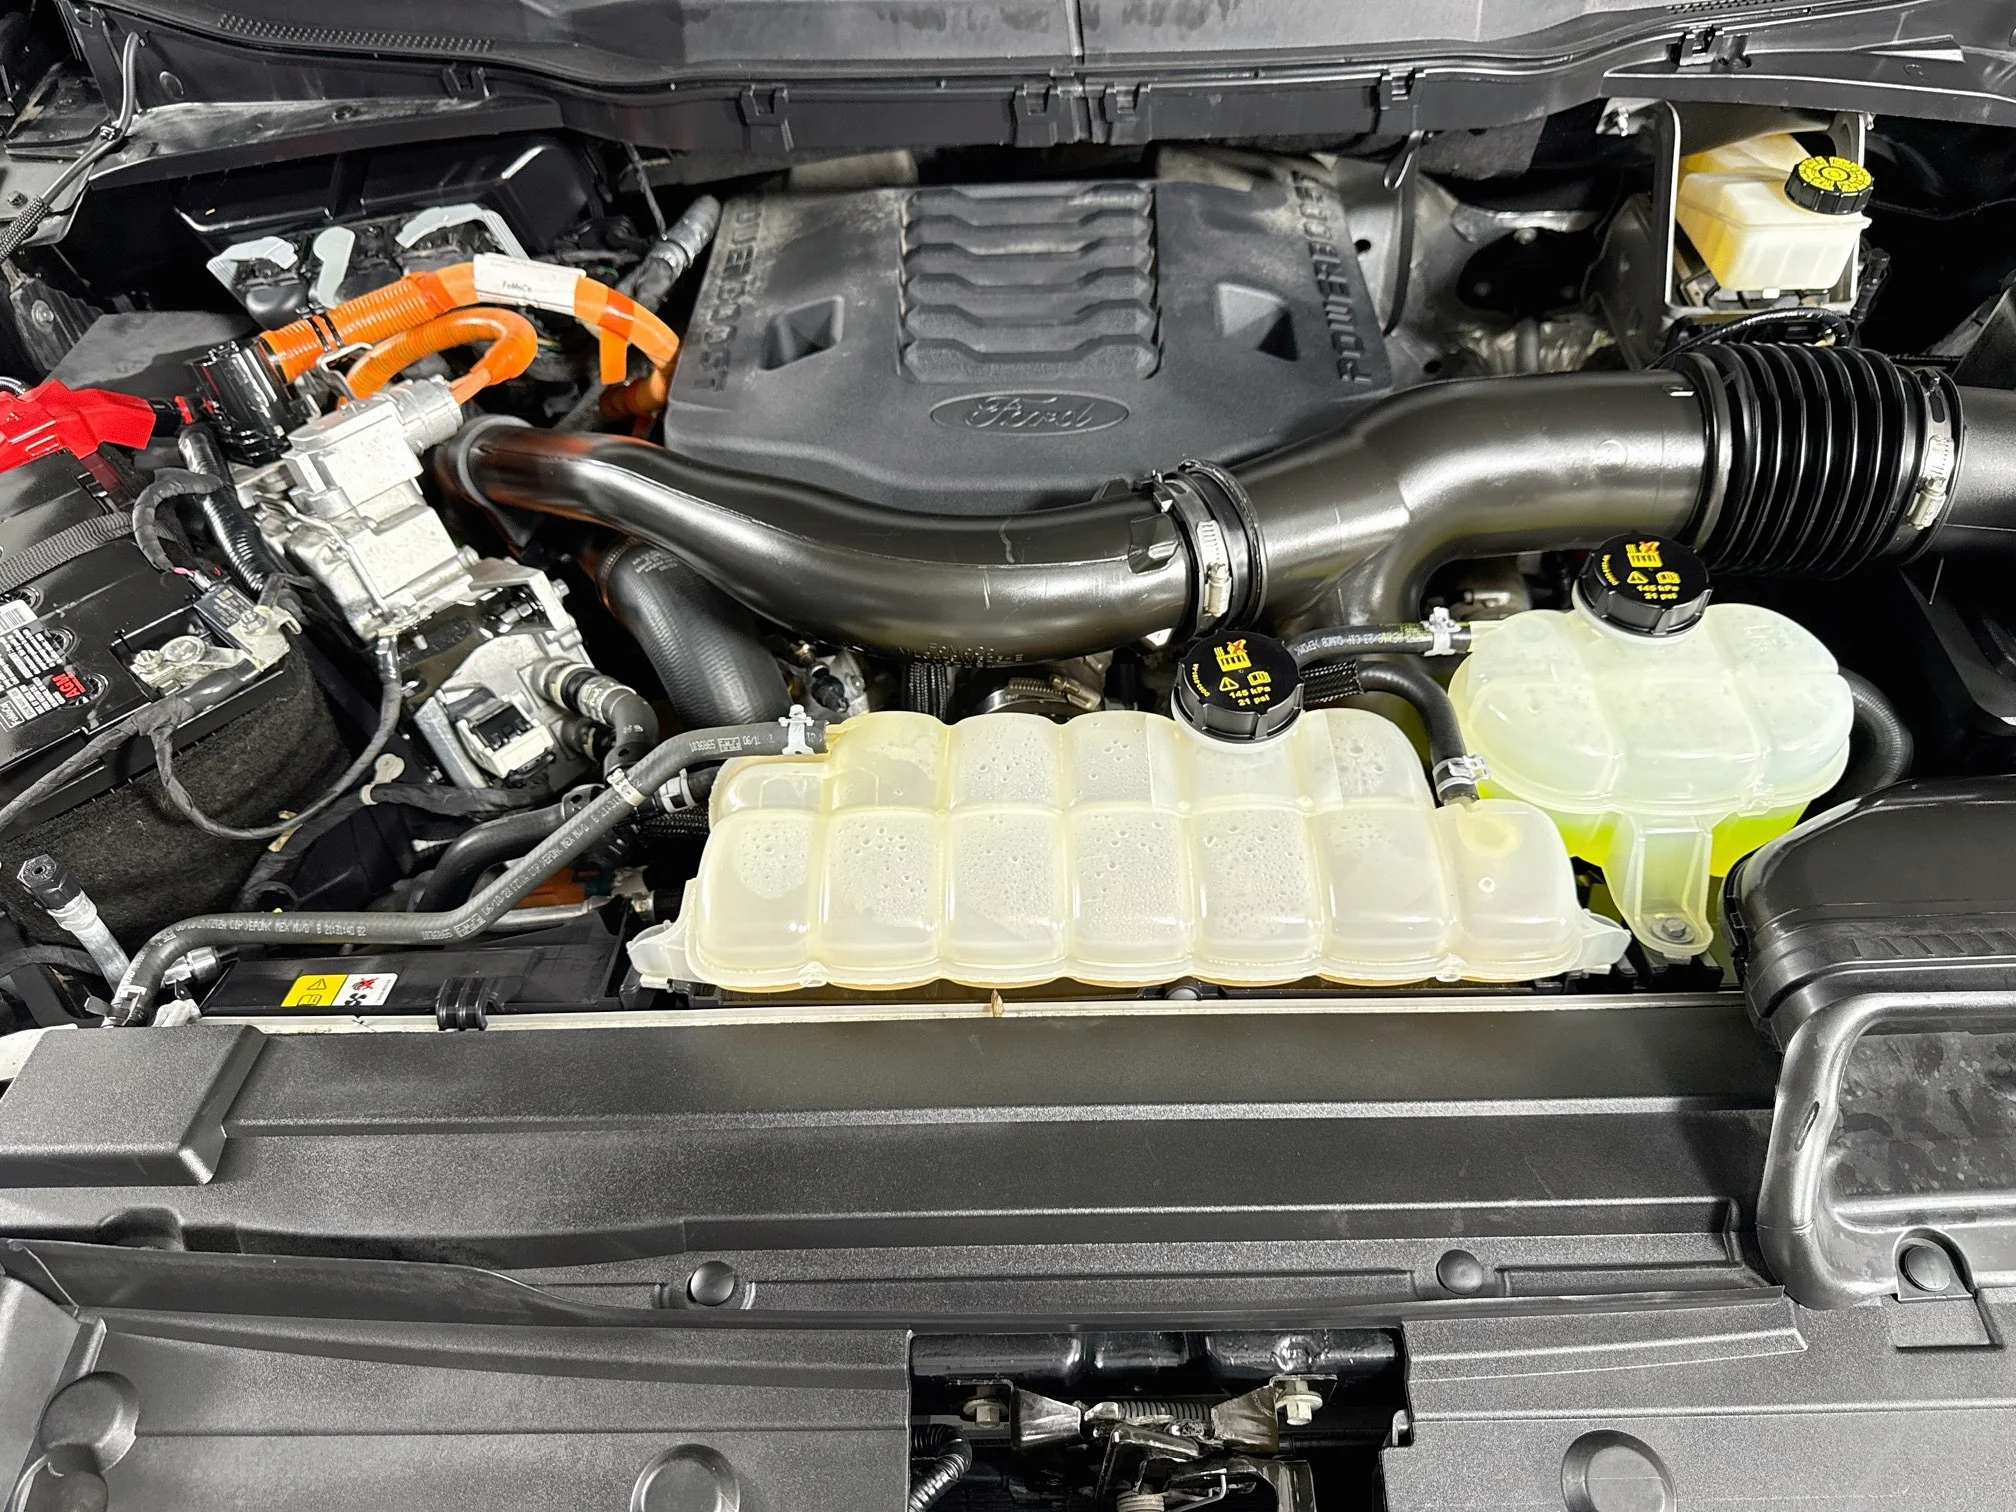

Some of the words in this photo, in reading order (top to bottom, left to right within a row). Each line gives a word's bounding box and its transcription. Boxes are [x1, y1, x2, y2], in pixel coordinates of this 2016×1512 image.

[502, 281, 533, 293] FoMoCo
[965, 397, 1096, 428] Ford
[1636, 584, 1657, 592] 145
[1658, 584, 1680, 592] kPa
[52, 673, 81, 698] AGM
[1229, 688, 1249, 699] 145
[1250, 685, 1272, 696] kPa
[1237, 697, 1251, 707] 21
[1253, 694, 1271, 705] psi
[0, 702, 20, 726] FoMoCo
